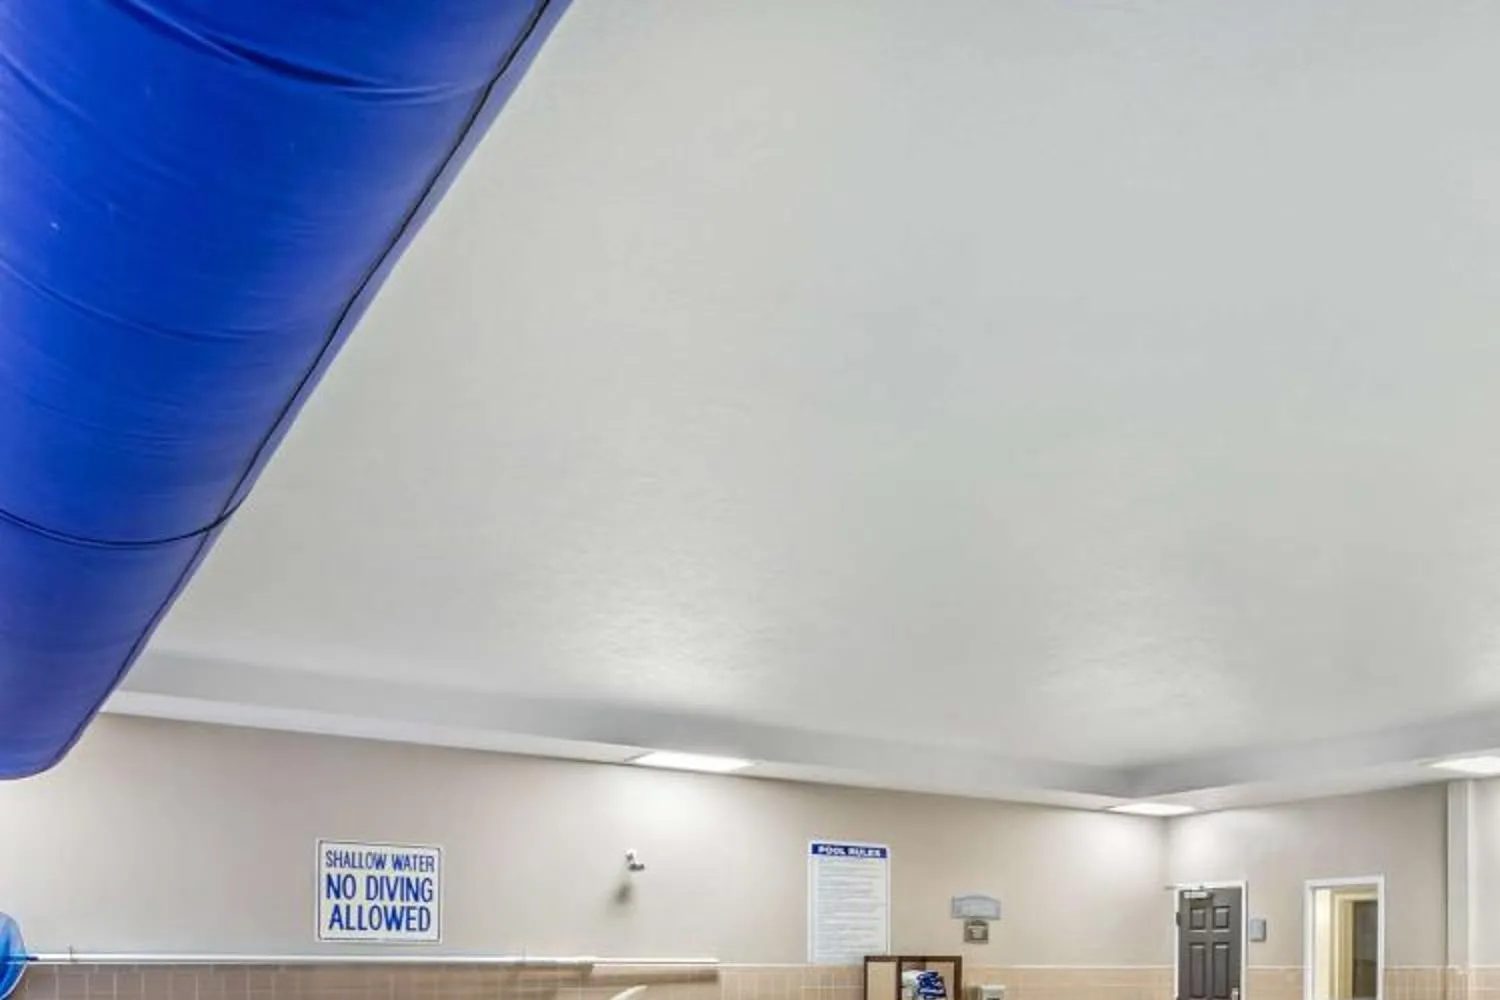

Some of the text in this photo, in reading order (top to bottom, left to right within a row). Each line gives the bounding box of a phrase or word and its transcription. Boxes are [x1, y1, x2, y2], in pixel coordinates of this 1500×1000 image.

[325, 850, 435, 872] SHALLOW WATER
[326, 873, 433, 903] NO DIVING
[328, 903, 431, 932] ALLOWED
